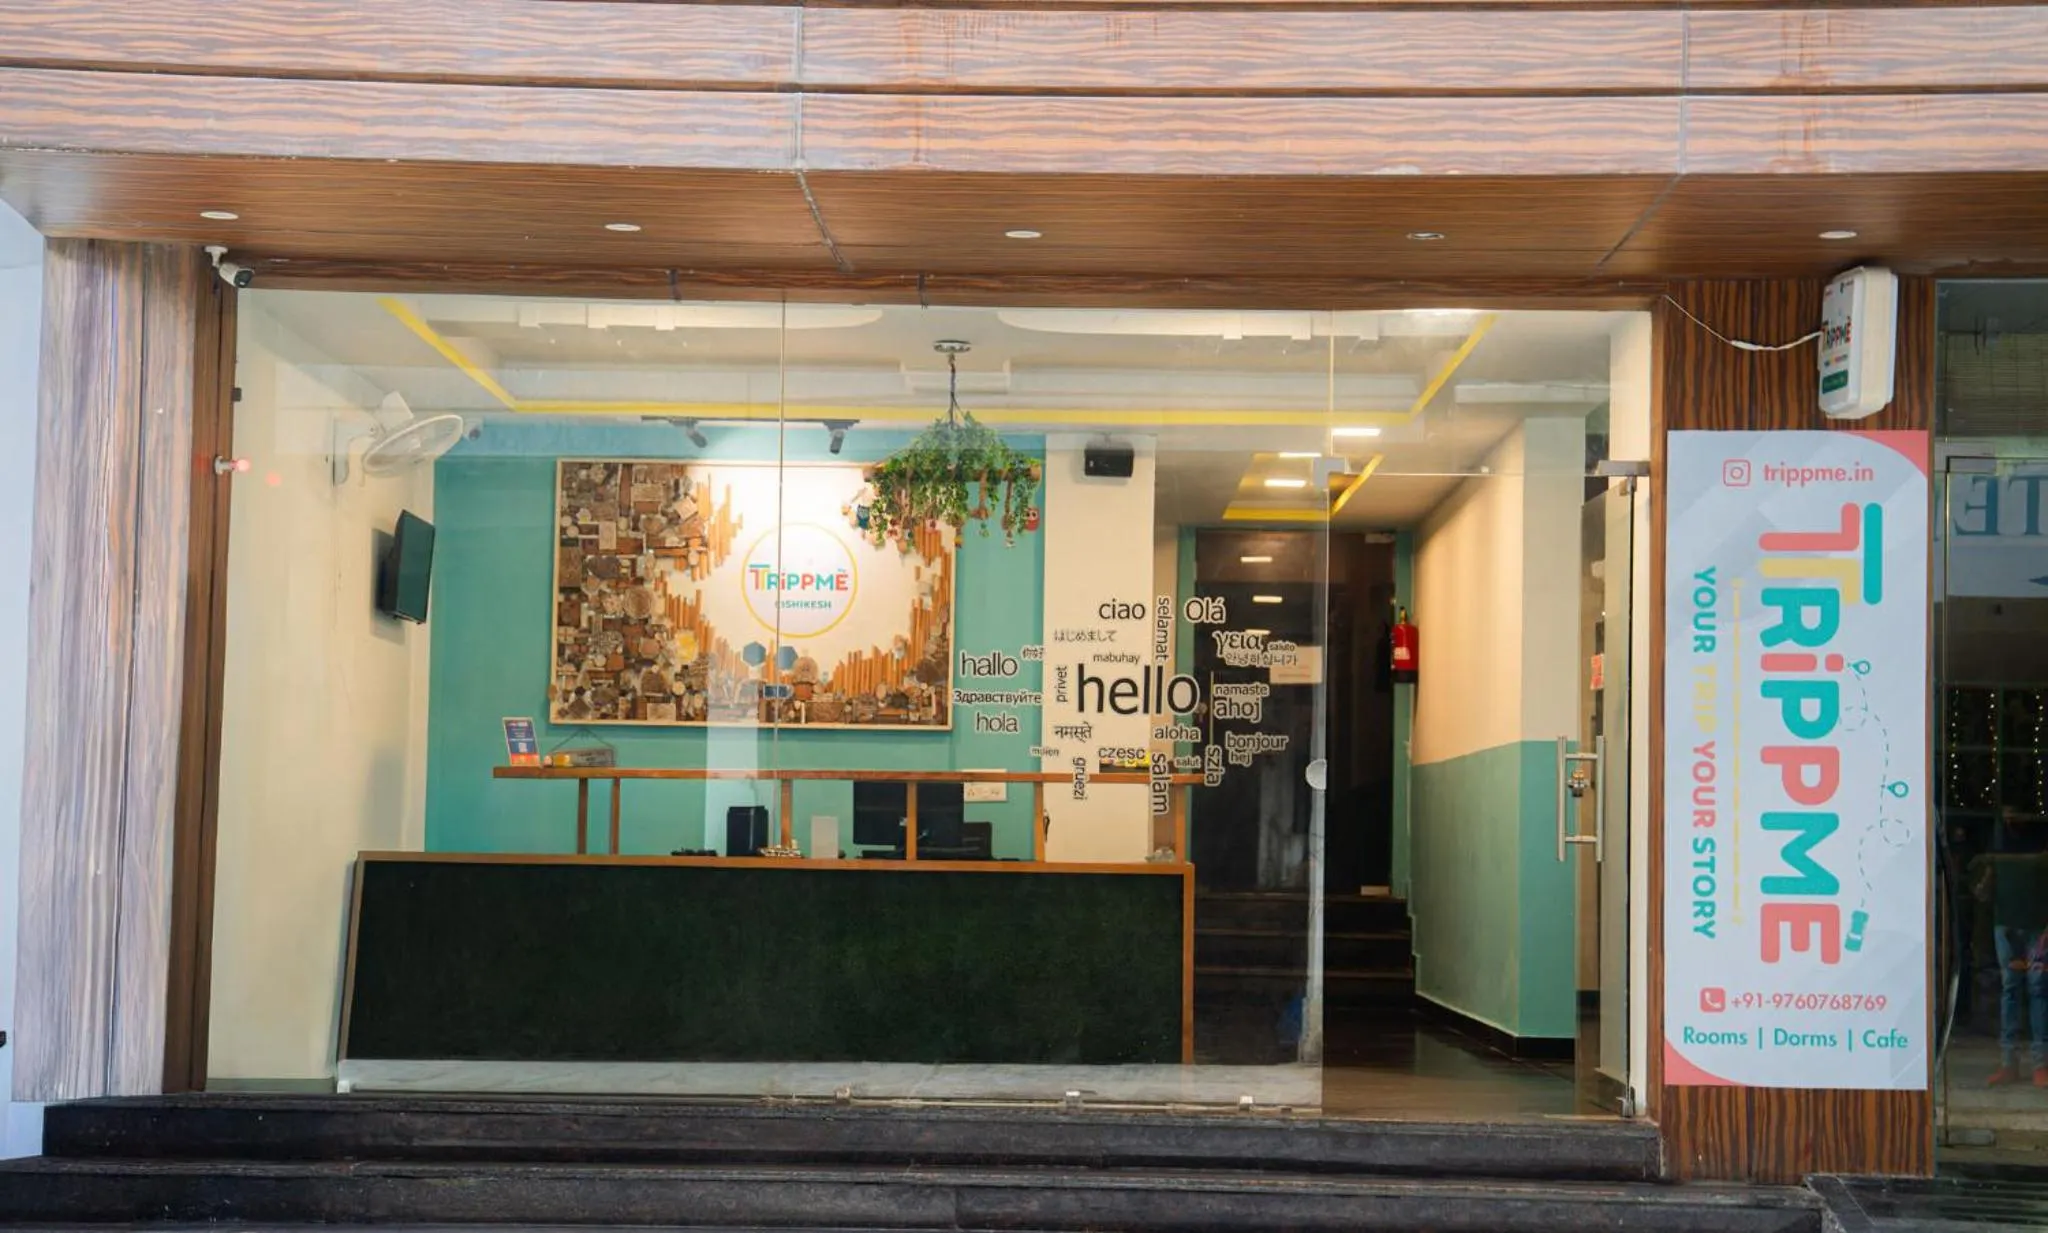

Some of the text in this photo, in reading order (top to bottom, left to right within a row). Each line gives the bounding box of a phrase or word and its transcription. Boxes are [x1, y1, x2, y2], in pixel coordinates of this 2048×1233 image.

[1764, 462, 1873, 487] trippme.in
[1099, 598, 1146, 620] ciao
[1186, 598, 1225, 621] Olá
[1155, 597, 1172, 661] selamat
[961, 652, 1018, 676] hallo
[1093, 652, 1140, 664] mabuhay
[1055, 665, 1068, 703] privet
[1077, 663, 1199, 715] hello
[1215, 684, 1268, 695] namaste
[954, 690, 1042, 704] Здравствуйте
[1215, 697, 1261, 720] ahoj
[976, 712, 1018, 732] hola
[1055, 721, 1092, 743] नमस्ते
[1154, 726, 1200, 741] aloha
[1226, 732, 1287, 752] bonjour
[1230, 751, 1251, 765] hej
[1692, 566, 1717, 939] YOUR TRIP YOUR STORY
[1207, 747, 1223, 785] szia
[1151, 754, 1171, 813] salam
[1732, 993, 1887, 1011] +91-9760768769
[1683, 1027, 1747, 1045] Rooms
[1774, 1029, 1837, 1047] Dorms
[1863, 1030, 1908, 1048] Cafe
